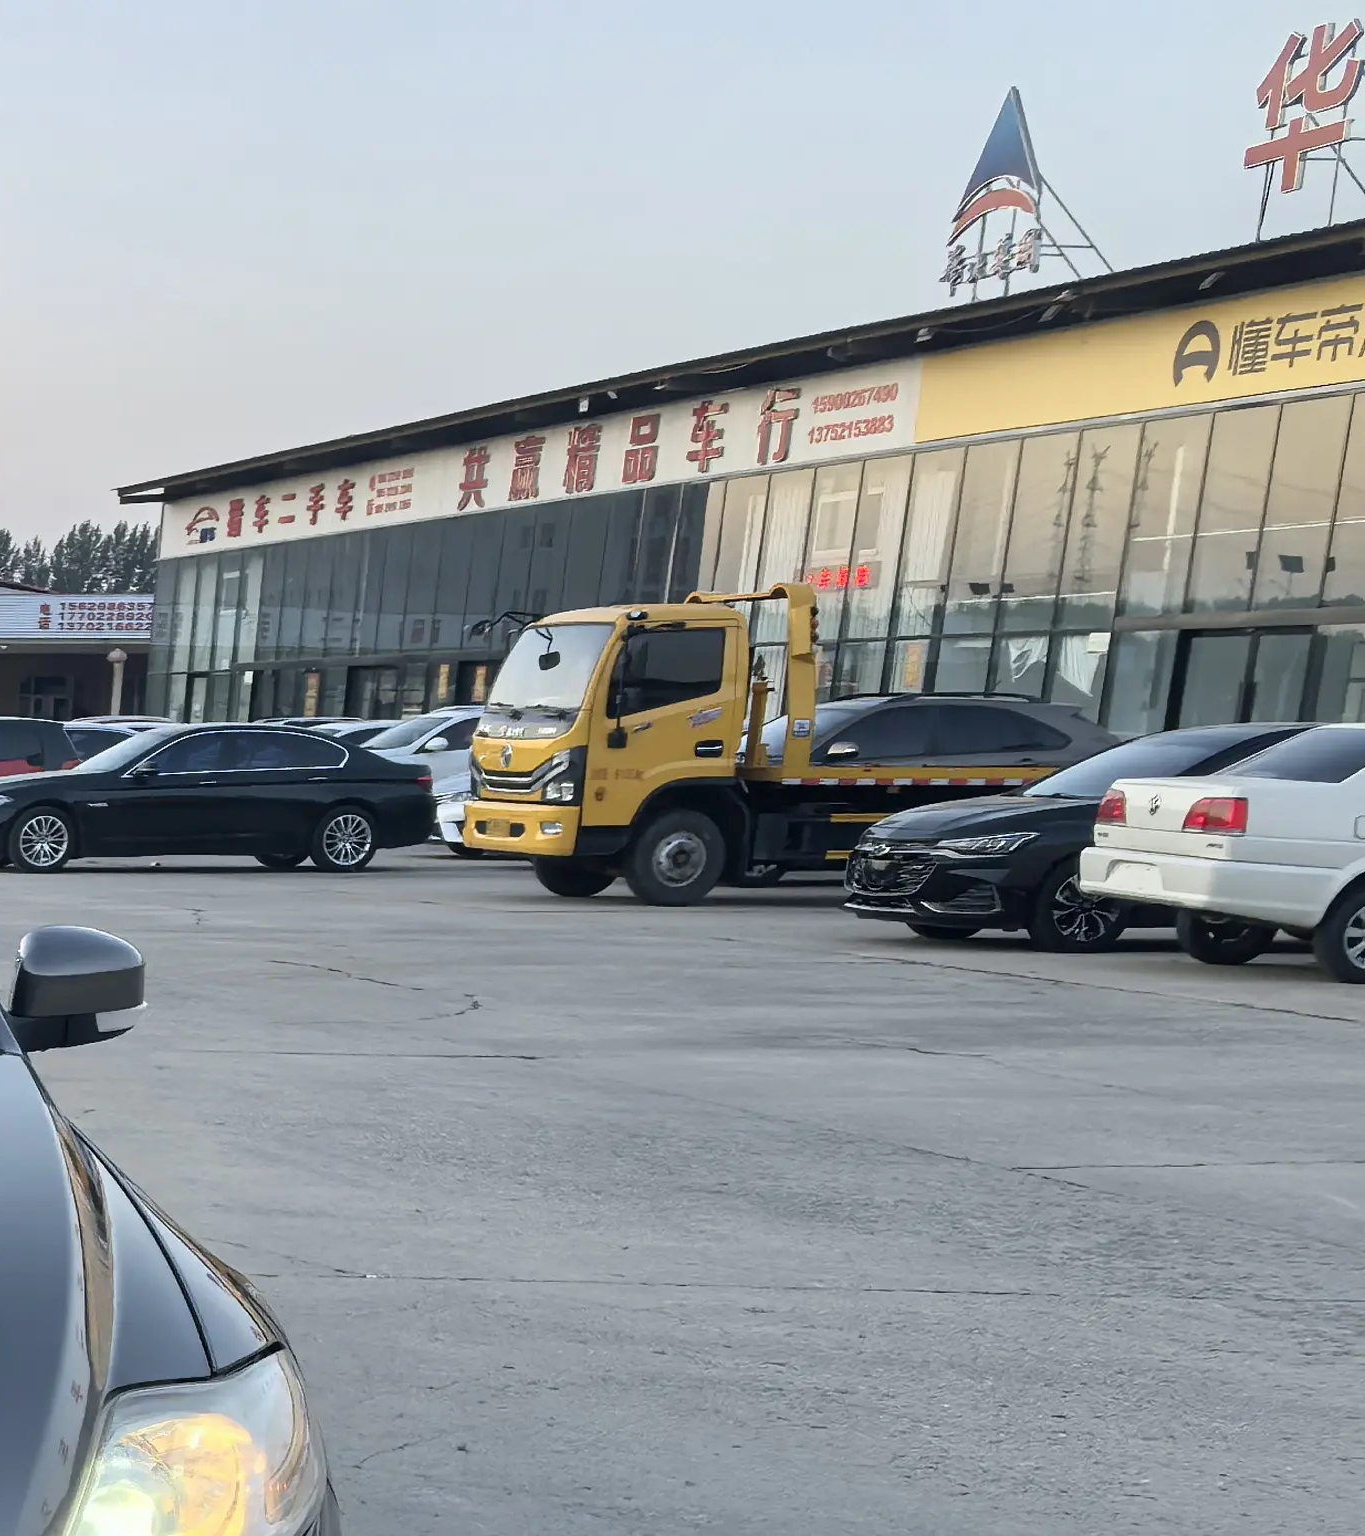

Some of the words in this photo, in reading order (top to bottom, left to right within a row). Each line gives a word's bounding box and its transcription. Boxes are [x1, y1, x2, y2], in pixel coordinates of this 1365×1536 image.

[1244, 19, 1364, 194] 华
[1228, 303, 1364, 376] 懂车帝
[457, 388, 801, 512] 共赢精品车行
